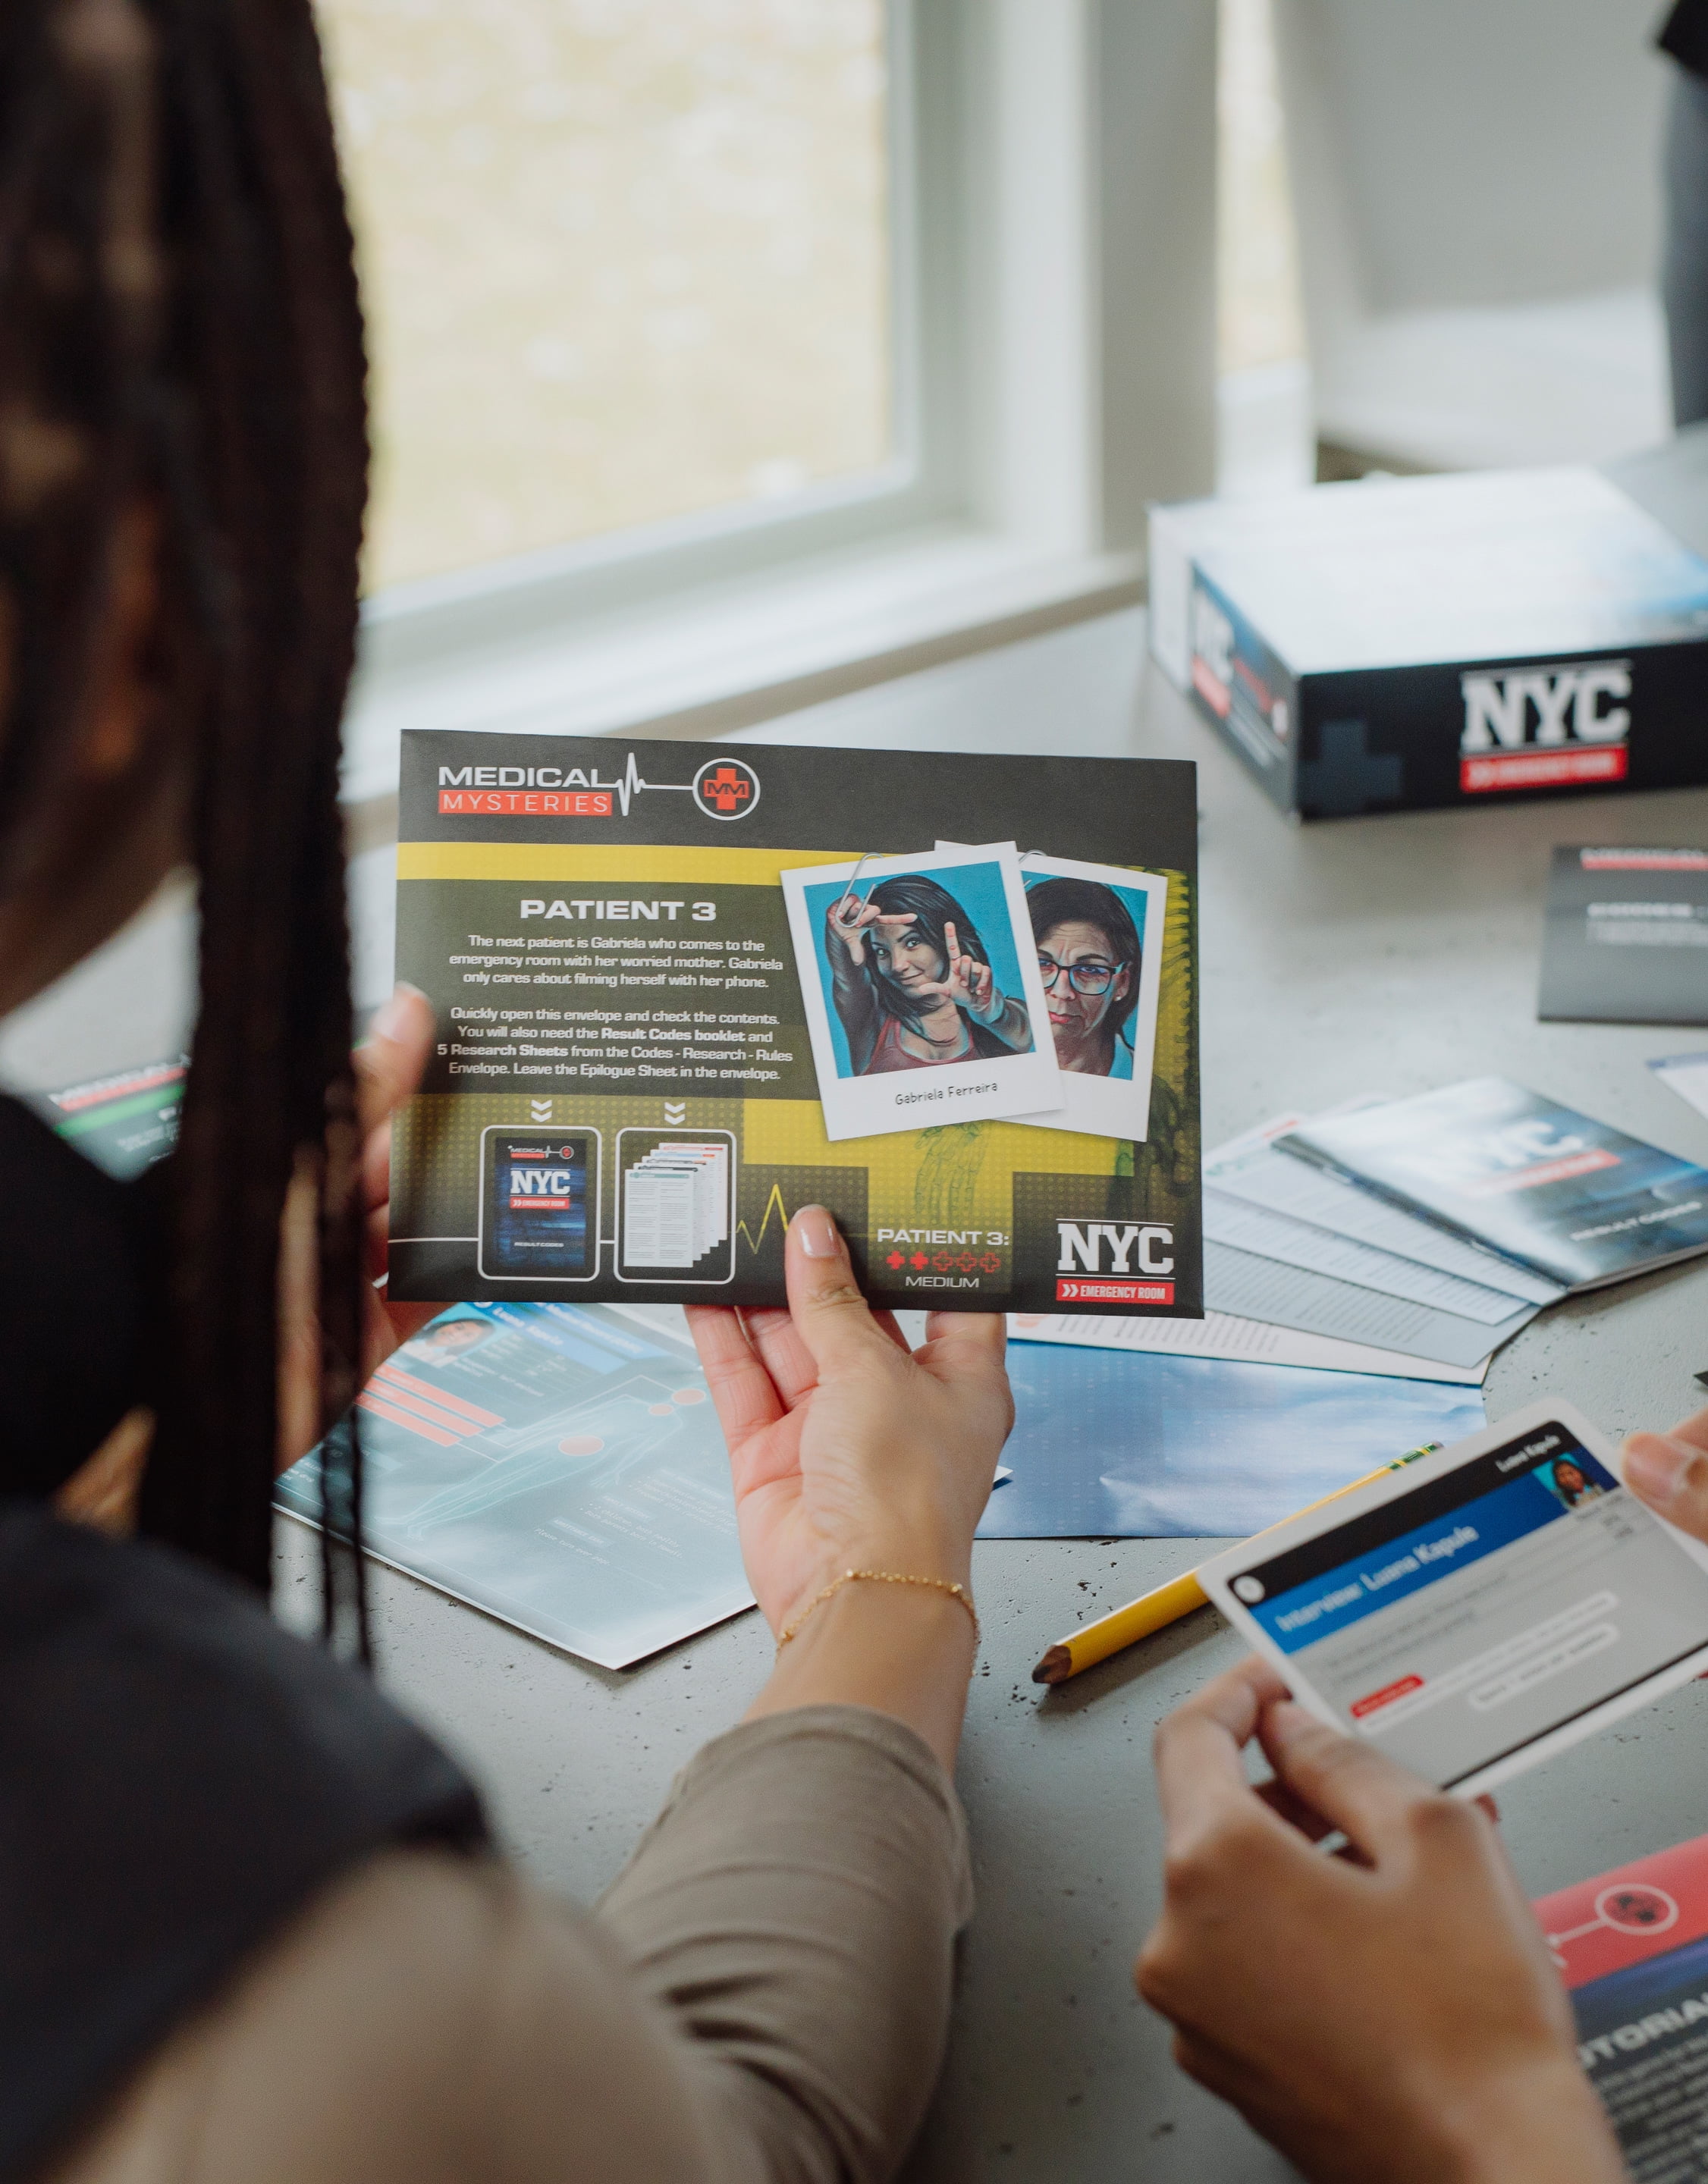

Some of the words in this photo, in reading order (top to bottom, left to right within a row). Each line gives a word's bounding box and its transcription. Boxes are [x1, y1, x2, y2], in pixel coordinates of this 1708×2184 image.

[1461, 667, 1631, 752] NYC
[438, 766, 609, 789] MEDICAL
[706, 782, 747, 796] MM
[442, 793, 608, 814] MYSTERIES
[520, 899, 685, 921] PATIENT
[692, 901, 717, 921] 3
[468, 934, 493, 946] The
[496, 937, 526, 947] next
[527, 936, 575, 950] patient
[576, 937, 589, 948] is
[591, 937, 645, 949] Gabriela
[648, 937, 677, 949] who
[679, 940, 724, 950] comes
[725, 940, 740, 951] to
[742, 940, 765, 952] the
[448, 955, 523, 968] emergency
[526, 956, 561, 966] room
[563, 954, 592, 966] with
[595, 955, 619, 967] her
[620, 956, 672, 968] worried
[673, 956, 726, 968] mother.
[728, 957, 783, 971] Gabriela
[463, 971, 491, 986] only
[492, 974, 531, 984] cares
[533, 972, 572, 985] about
[573, 973, 618, 988] filming
[620, 973, 667, 986] herself
[668, 974, 697, 987] with
[699, 974, 724, 987] her
[725, 976, 769, 990] phone.
[451, 1007, 499, 1022] Quickly
[500, 1010, 534, 1022] open
[535, 1009, 562, 1021] this
[564, 1009, 623, 1024] envelope
[624, 1010, 650, 1022] and
[651, 1010, 692, 1023] check
[693, 1011, 717, 1023] the
[718, 1013, 780, 1025] contents.
[457, 1025, 484, 1037] You
[486, 1025, 508, 1037] will
[510, 1026, 538, 1038] also
[541, 1027, 574, 1039] need
[576, 1027, 598, 1039] the
[601, 1028, 647, 1040] Result
[648, 1028, 692, 1041] Codes
[694, 1029, 746, 1042] booklet
[748, 1031, 774, 1043] and
[437, 1043, 448, 1056] 5
[451, 1043, 517, 1056] Research
[519, 1044, 569, 1057] Sheets
[570, 1045, 604, 1058] from
[606, 1046, 629, 1058] the
[631, 1046, 674, 1059] Codes
[683, 1047, 746, 1061] Research
[755, 1049, 793, 1062] Rules
[448, 1062, 510, 1077] Envelope.
[513, 1062, 553, 1075] Leave
[554, 1063, 578, 1075] the
[579, 1064, 636, 1079] Epilogue
[638, 1065, 678, 1078] Sheet
[680, 1065, 692, 1078] in
[694, 1066, 717, 1078] the
[720, 1068, 781, 1082] envelope.
[895, 1087, 943, 1105] Gabriela
[947, 1082, 999, 1098] Ferreira
[510, 1169, 571, 1195] NYC
[877, 1228, 983, 1245] PATIENT
[986, 1231, 1010, 1246] 3:
[1057, 1222, 1175, 1275] NYC
[905, 1276, 980, 1288] MEDIUM
[1080, 1285, 1137, 1299] EMERGENCY
[1138, 1287, 1166, 1300] ROOM
[1581, 1991, 1708, 2070] TORIA
